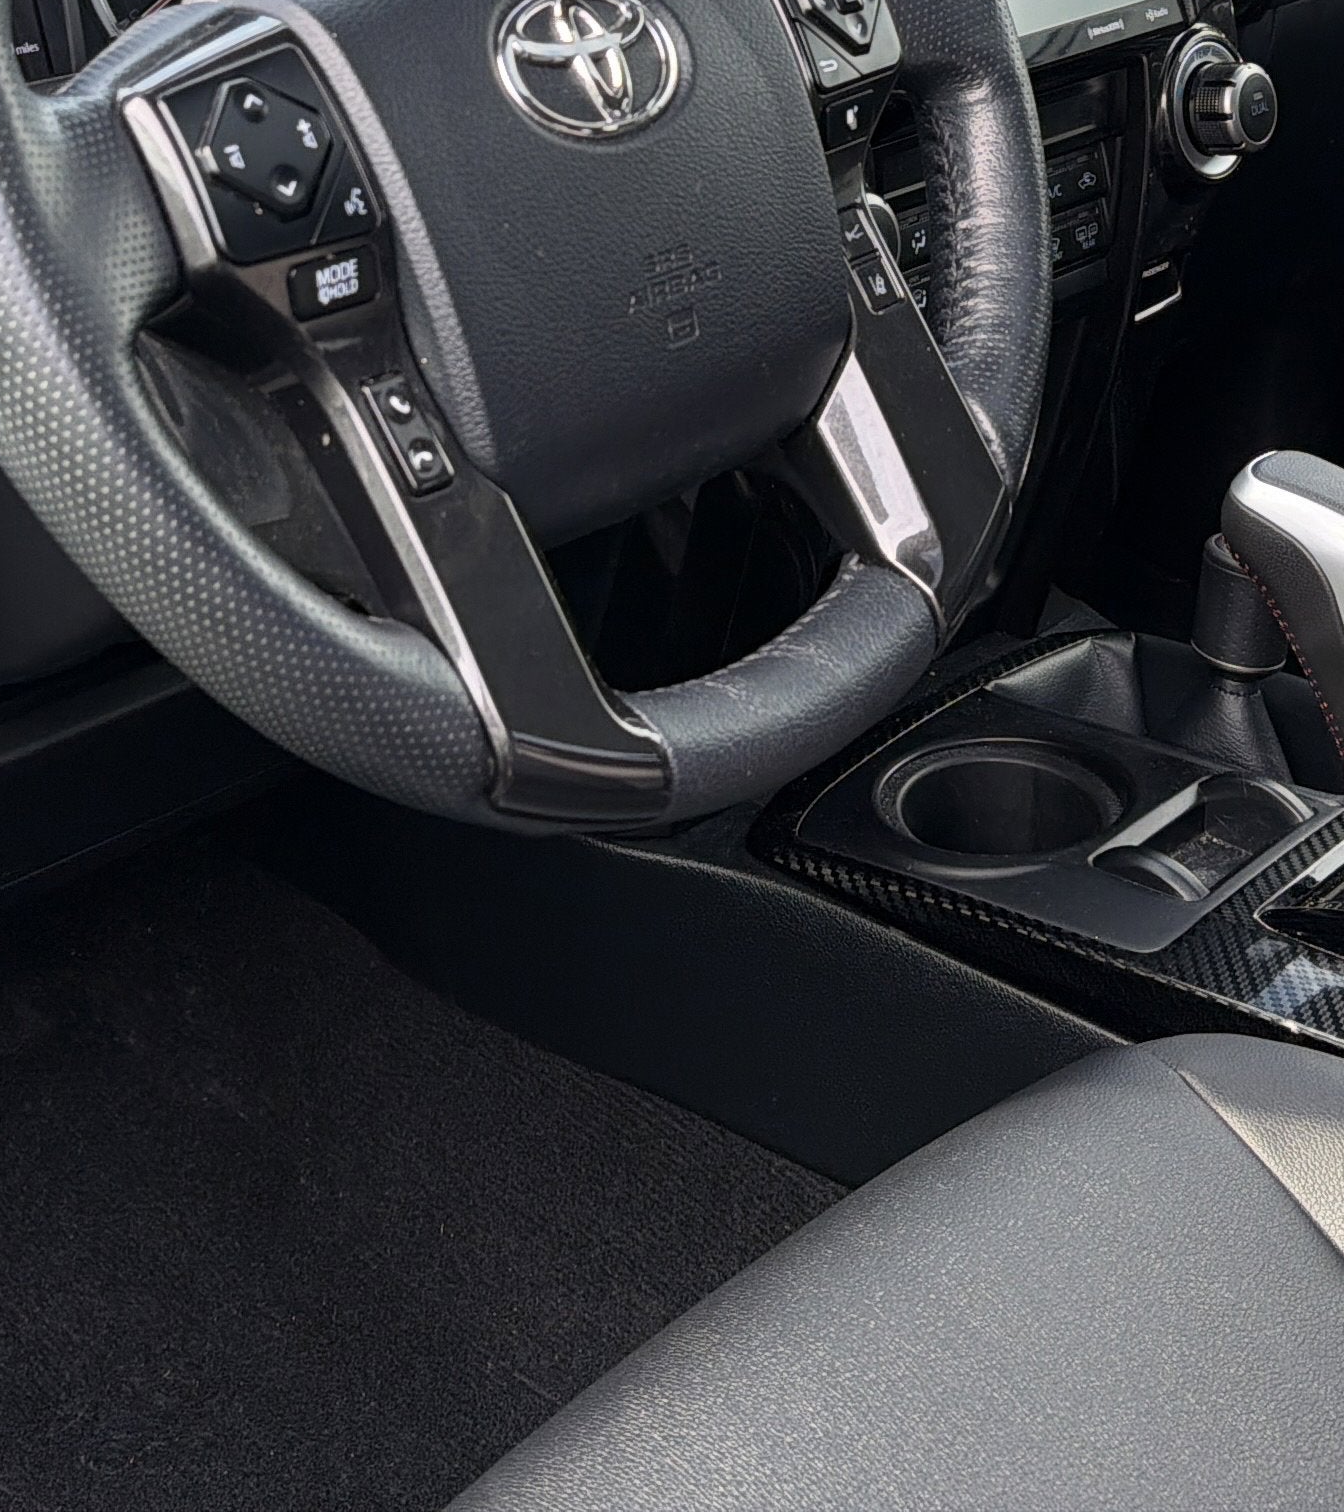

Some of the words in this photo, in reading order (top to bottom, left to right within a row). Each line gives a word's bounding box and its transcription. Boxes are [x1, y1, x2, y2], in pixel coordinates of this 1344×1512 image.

[16, 42, 40, 56] miles
[1251, 102, 1269, 117] DUAL
[315, 257, 359, 289] MODE
